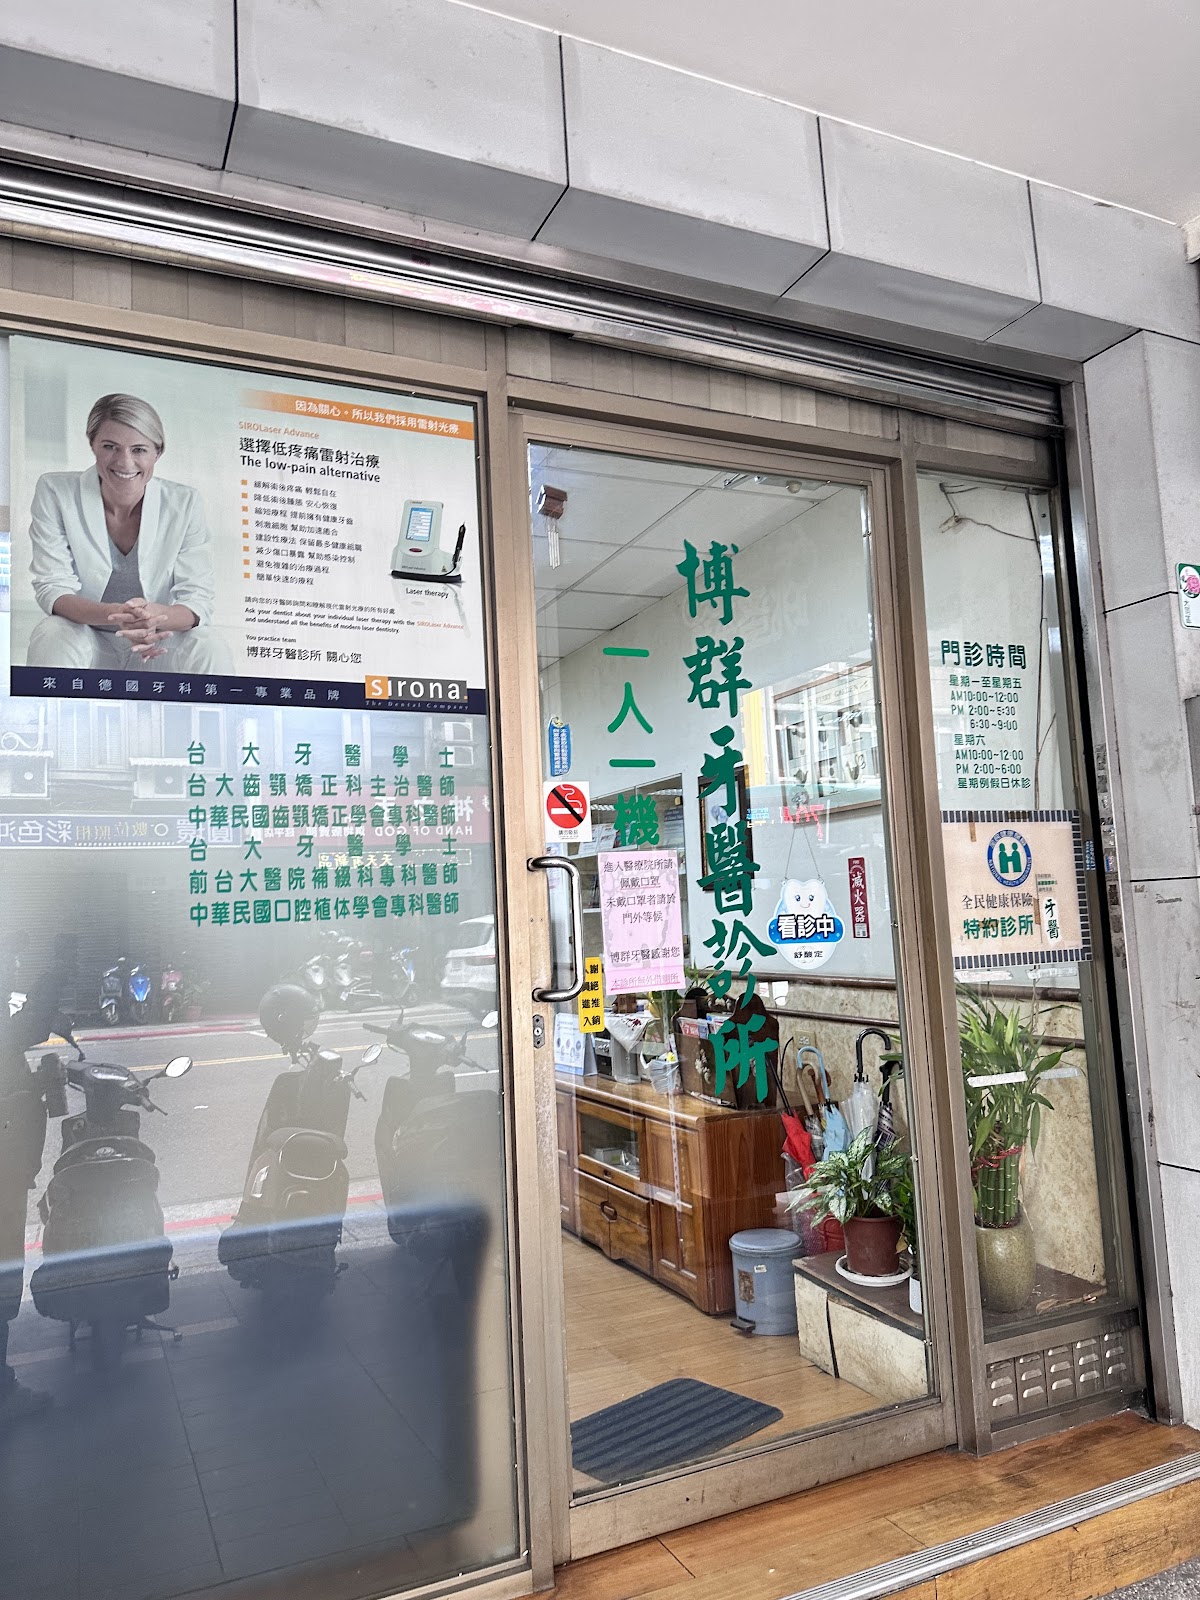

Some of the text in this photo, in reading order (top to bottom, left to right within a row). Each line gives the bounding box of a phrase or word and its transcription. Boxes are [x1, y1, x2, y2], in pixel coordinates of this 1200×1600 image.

[238, 421, 320, 440] SIROLaser Advance
[239, 437, 380, 469] 選擇低疼痛雷射治療
[240, 455, 381, 483] The low-pain alternative
[405, 587, 449, 599] Laser therapy
[246, 645, 362, 665] 博群牙醫診所 關心您
[941, 640, 1027, 670] 門診時間
[43, 676, 340, 702] 來自德國牙科第一專業品牌
[949, 674, 1022, 689] 星期一至星期五
[951, 704, 965, 715] PM
[602, 647, 660, 846] 一人一機
[954, 734, 986, 746] 星期六
[187, 741, 454, 768] 台大牙醫學士
[956, 764, 969, 774] PM
[188, 773, 455, 797] 台大齒顎矯正科主治醫師
[958, 777, 1031, 789] 星期例假日休診
[188, 803, 457, 829] 中華民國齒顎矯正學會專科醫師
[676, 538, 779, 1104] 博群牙醫診所
[189, 833, 457, 862] 台大牙醫學士
[603, 858, 674, 873] 進入醫療院所請
[189, 863, 458, 894] 前台大醫院補綴科專科醫師
[606, 893, 676, 908] 未戴口罩者請於
[852, 871, 866, 923] 滅火器
[961, 893, 1034, 910] 全民健康保險
[622, 911, 663, 925] 門外等候
[778, 914, 834, 940] 看診中
[963, 915, 1034, 940] 特約診所
[1044, 898, 1060, 939] 牙醫
[610, 946, 680, 964] 博群牙醫感謝您
[794, 950, 824, 959] 舒酸定
[589, 963, 601, 1026] 謝絕推銷
